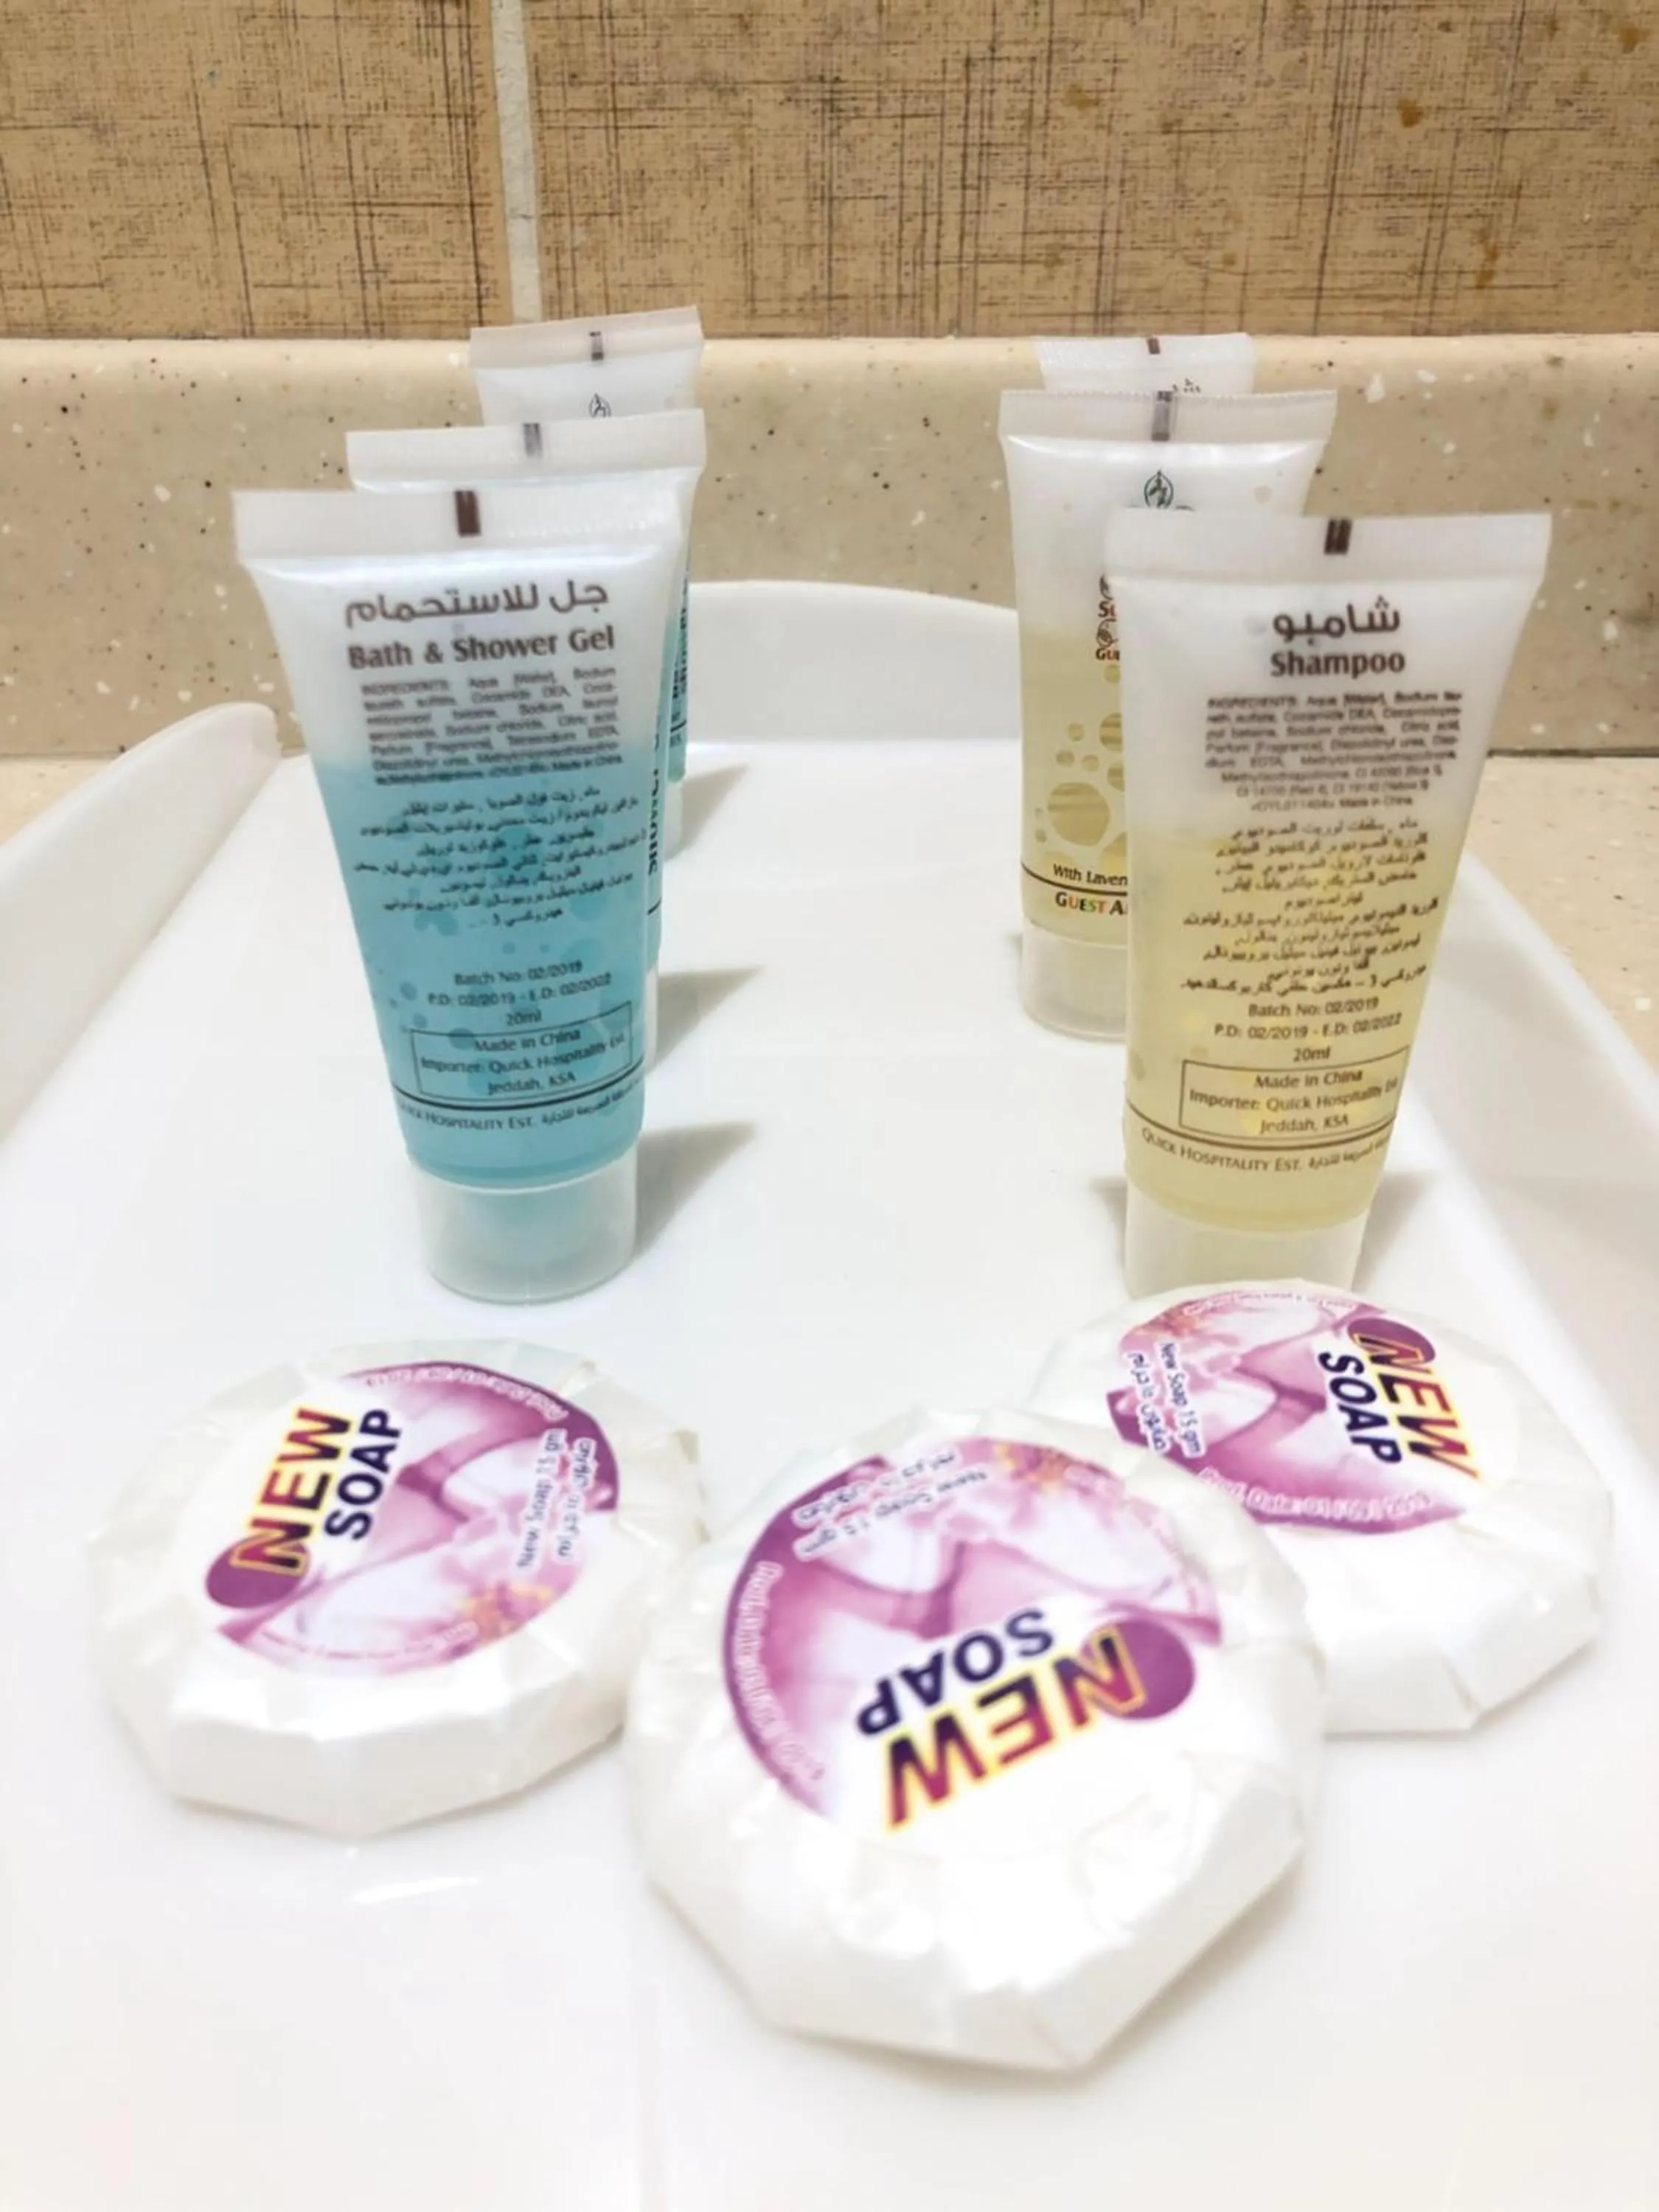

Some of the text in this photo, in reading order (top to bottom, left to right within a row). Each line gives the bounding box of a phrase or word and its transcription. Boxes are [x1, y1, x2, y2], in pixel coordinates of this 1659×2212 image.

[346, 579, 608, 628] جل للاستحمام
[1273, 594, 1400, 646] شامبو
[348, 625, 615, 669] Bath & Shower Gel
[1270, 650, 1405, 680] Shampoo
[1053, 863, 1082, 882] With
[454, 970, 495, 987] Batch
[528, 960, 583, 980] 02/2019
[458, 992, 515, 1007] 02/2019
[1249, 997, 1379, 1018] Batch No: 02/2019
[506, 1009, 542, 1026] 20ml
[1214, 1023, 1242, 1037] P.D:
[1248, 1025, 1308, 1040] 02/2019
[1352, 1012, 1402, 1034] 02/2022
[475, 1029, 581, 1052] Made in China
[1293, 1046, 1331, 1062] 20ml
[488, 1054, 532, 1074] Quick
[537, 1042, 606, 1068] Hospitality
[549, 1071, 577, 1088] KSA
[1254, 1070, 1363, 1089] Made in China
[1266, 1095, 1312, 1113] Quick
[1316, 1084, 1382, 1110] Hospitality
[1324, 1114, 1349, 1130] KSA
[1180, 1146, 1270, 1172] HOSPITALITY
[1318, 1350, 1403, 1464] SOAP
[1354, 1332, 1481, 1480] NEW
[324, 1408, 402, 1540] SOAP
[232, 1406, 352, 1571] NEW
[858, 1609, 1055, 1736] SOAP
[887, 1630, 1145, 1826] NEW
